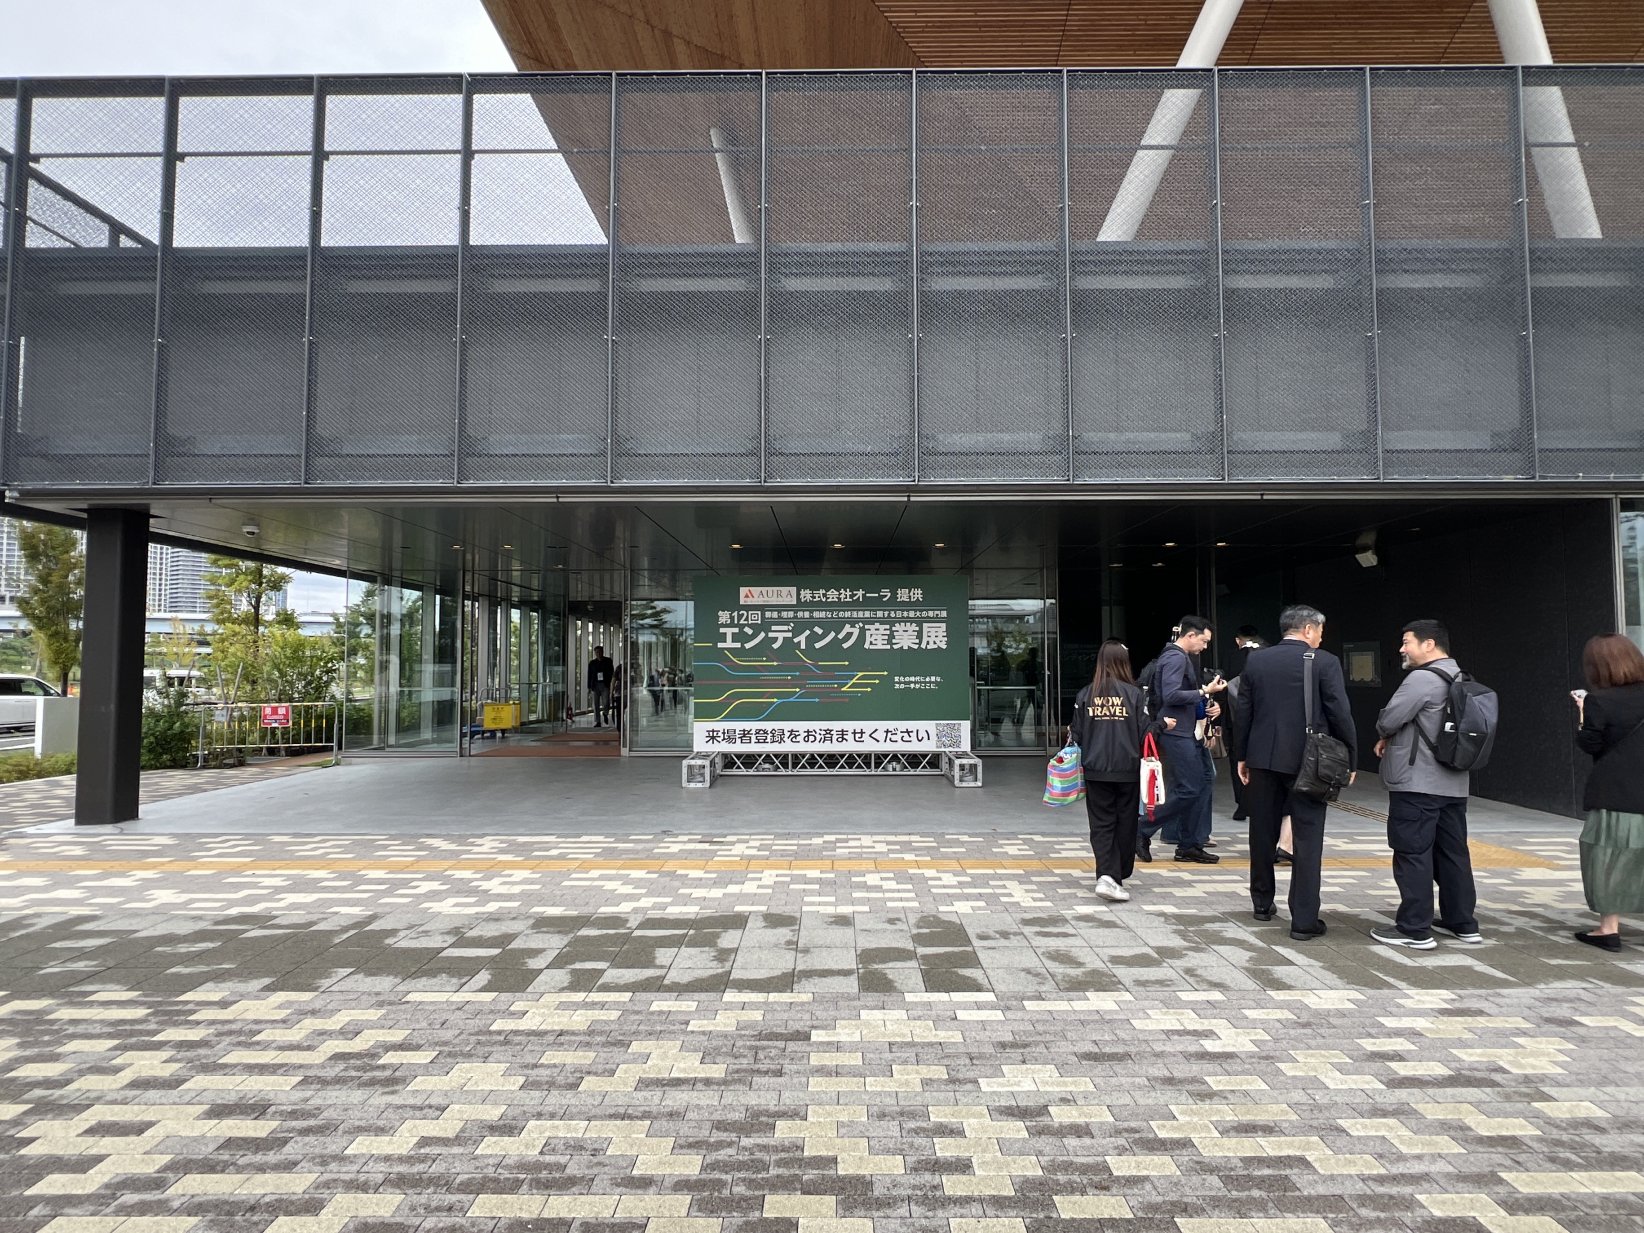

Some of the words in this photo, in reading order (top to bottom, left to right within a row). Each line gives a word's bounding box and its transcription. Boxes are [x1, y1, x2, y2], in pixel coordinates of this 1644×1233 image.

[757, 589, 794, 598] AURA
[799, 588, 892, 602] 株式会社オーラ
[896, 588, 923, 602] 提供
[717, 610, 762, 625] 第12回
[717, 622, 948, 650] エンディング産業展
[1094, 696, 1123, 706] WOW
[1087, 706, 1129, 717] TRAVEL
[705, 728, 931, 744] 来場者登録をお済ませください
